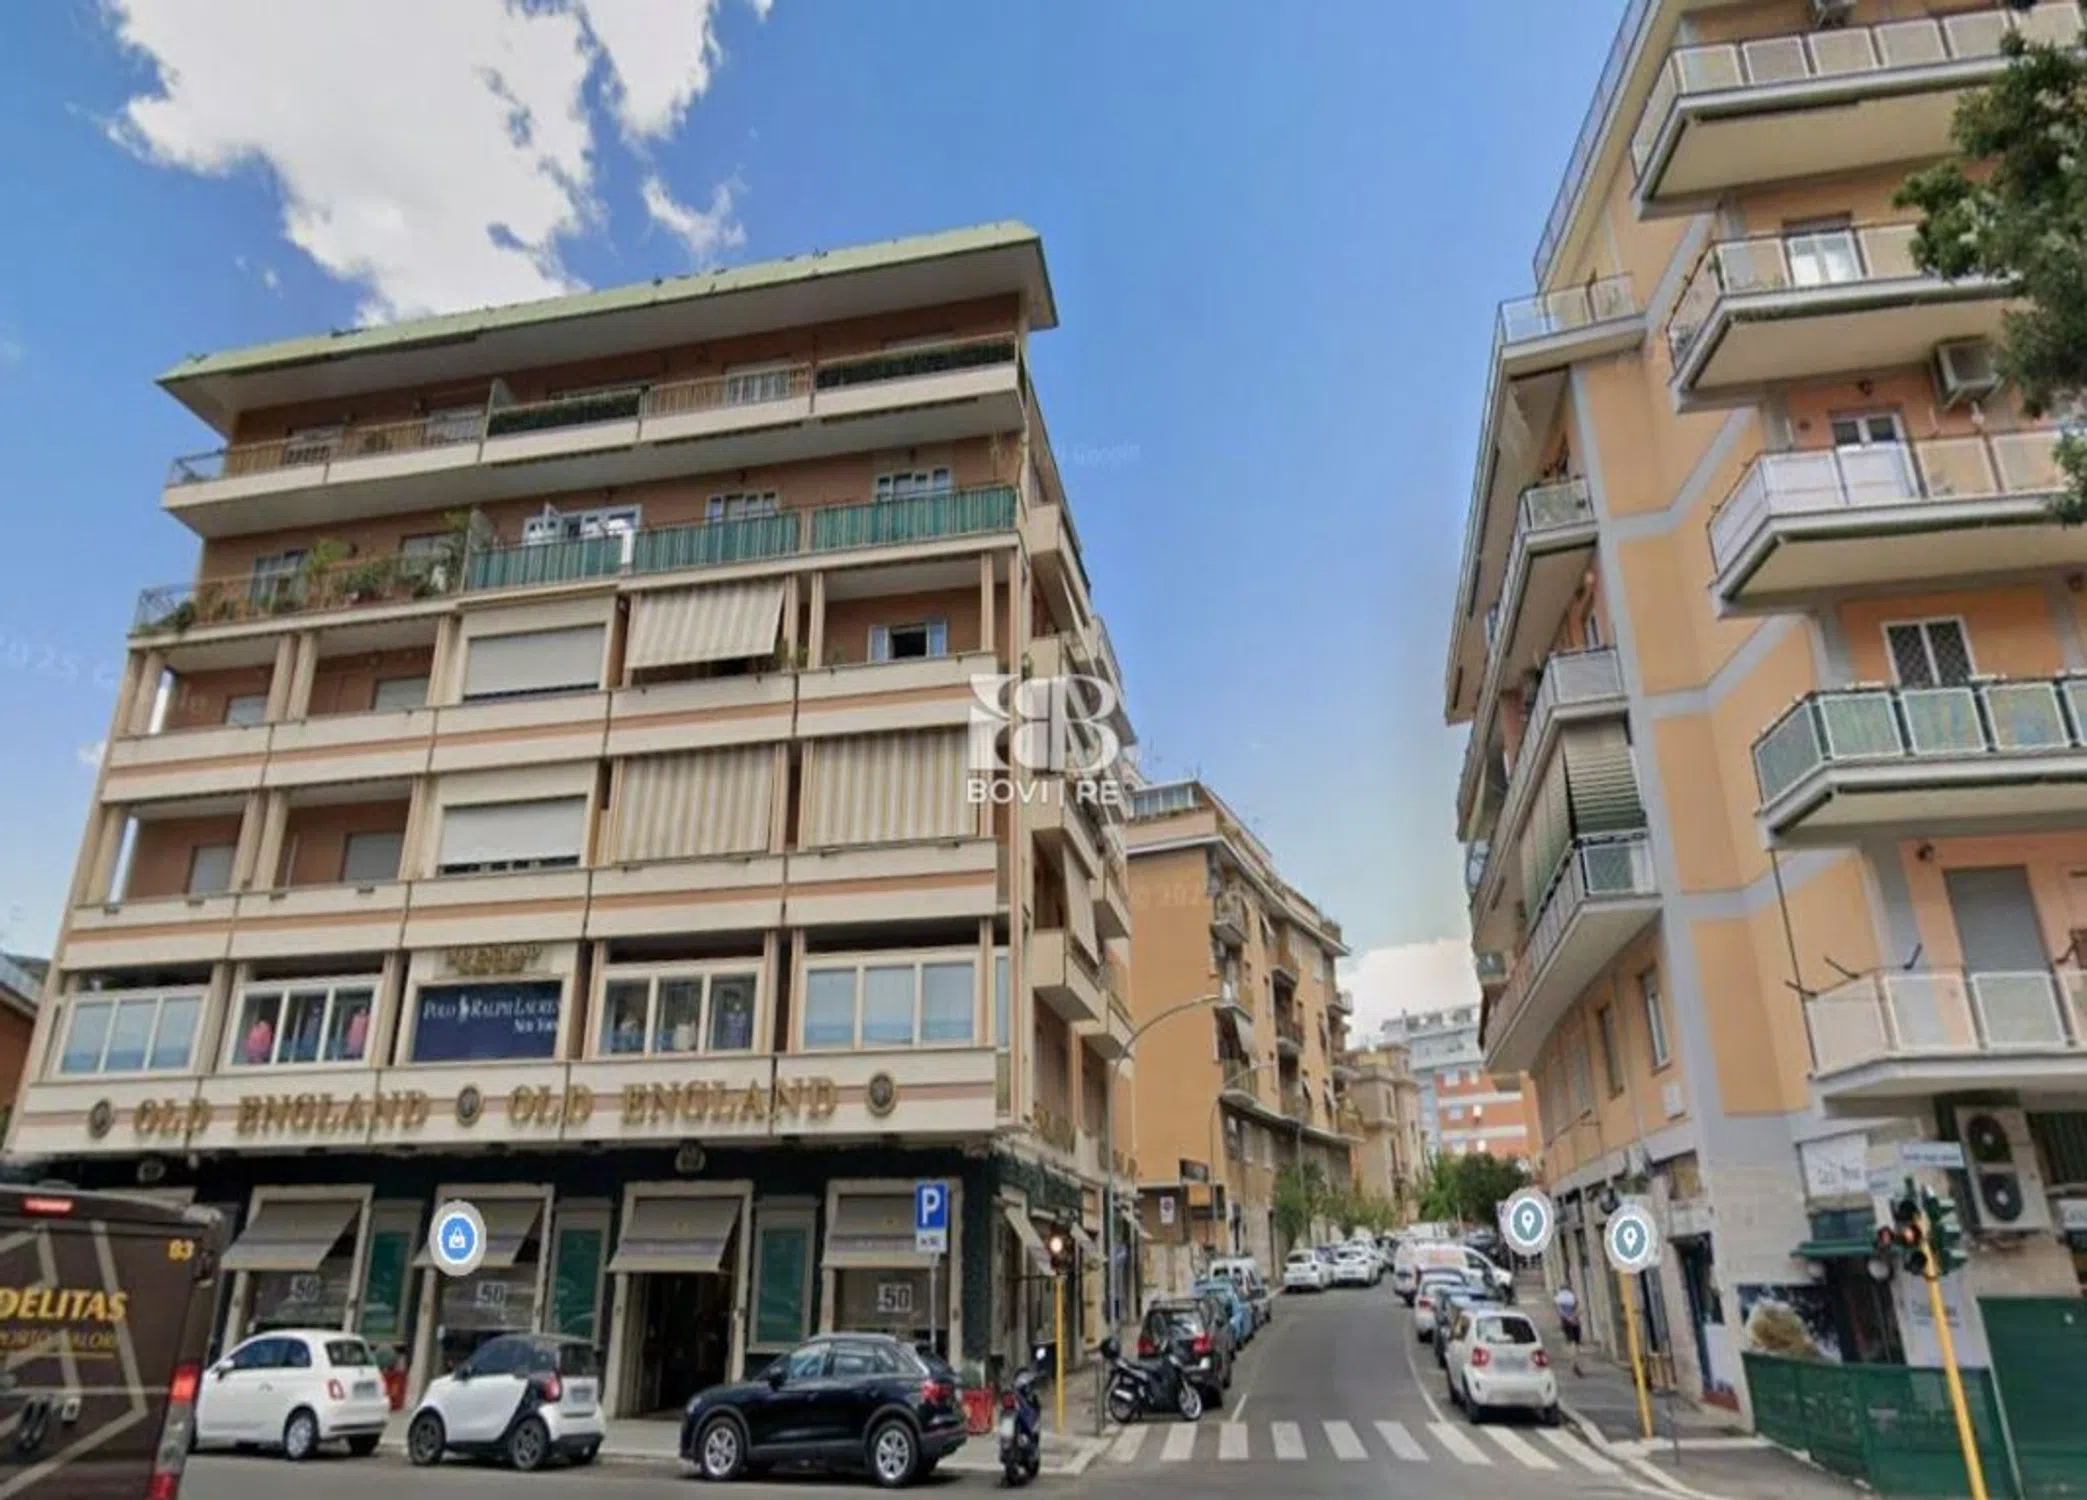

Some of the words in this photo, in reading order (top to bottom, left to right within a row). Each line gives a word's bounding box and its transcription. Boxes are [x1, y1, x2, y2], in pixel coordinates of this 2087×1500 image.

[133, 1096, 213, 1135] OLD
[236, 1088, 432, 1135] ENGLAND
[507, 1083, 595, 1125] OLD
[621, 1075, 840, 1125] ENGLAND
[921, 1188, 942, 1225] P
[0, 1287, 129, 1322] DELITAS
